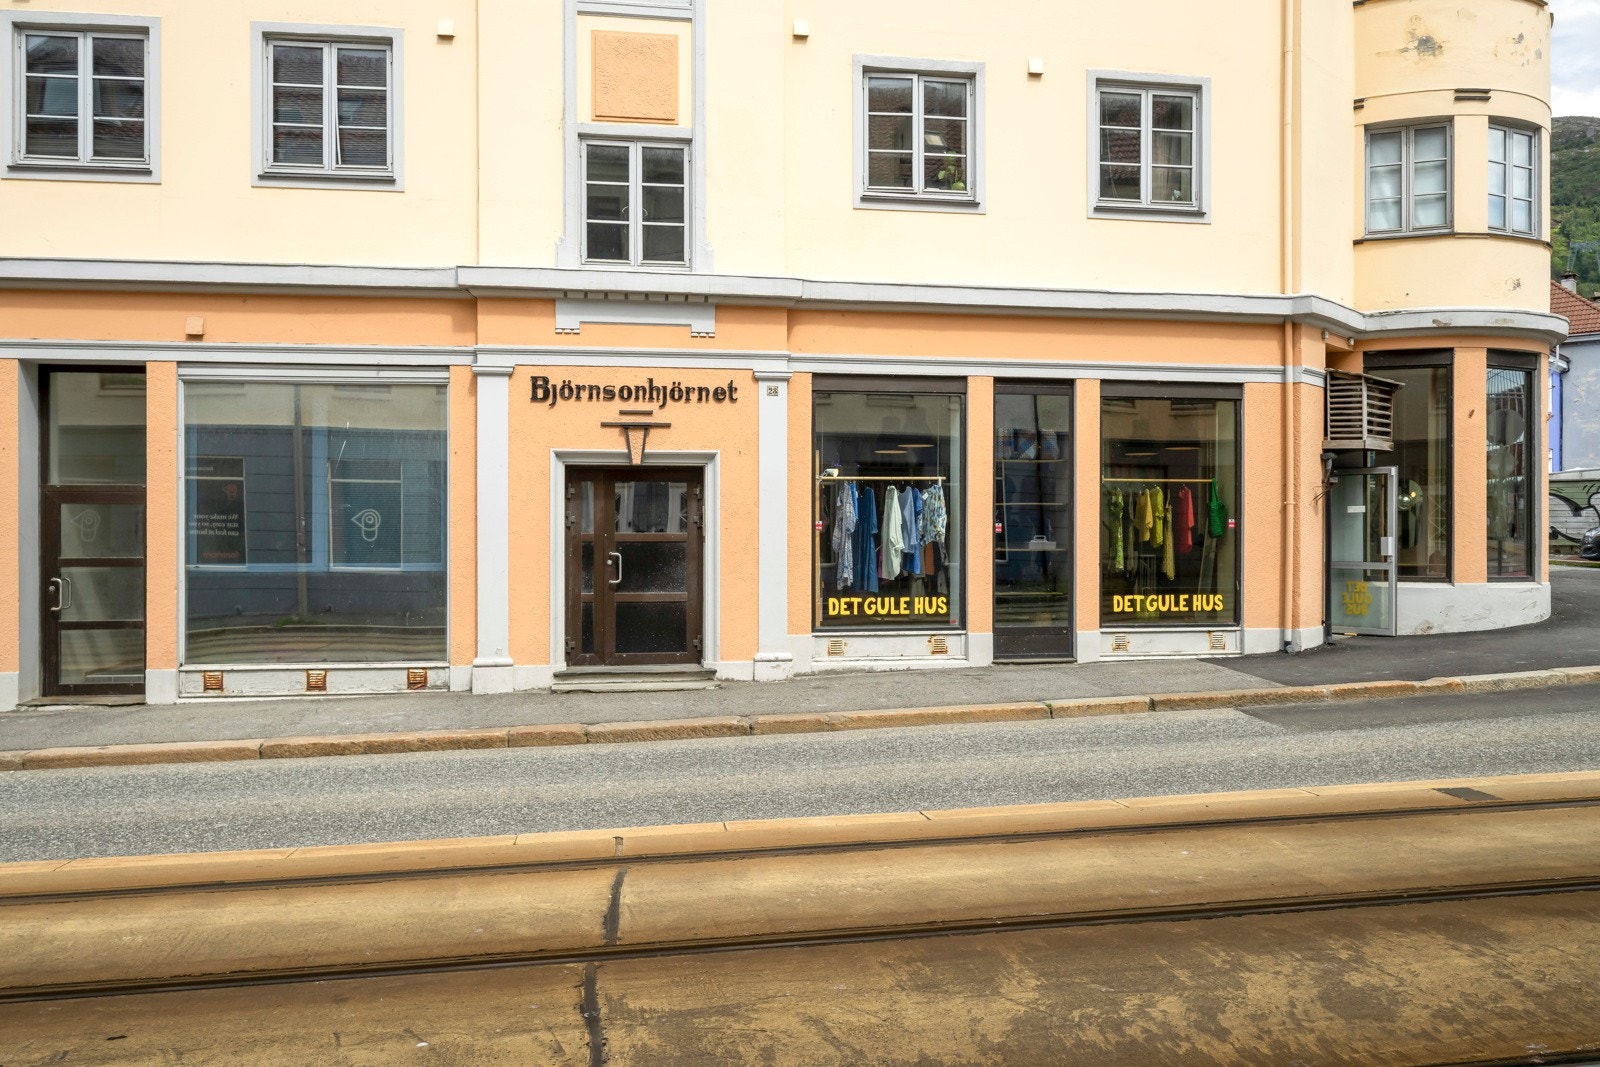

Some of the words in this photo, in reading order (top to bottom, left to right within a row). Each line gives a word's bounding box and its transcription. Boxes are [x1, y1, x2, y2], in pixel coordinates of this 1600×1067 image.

[530, 375, 738, 409] Björnsonhjörnet
[828, 597, 862, 616] DET
[864, 596, 911, 615] GULE
[914, 596, 948, 615] HUS
[1113, 594, 1144, 612] DET
[1146, 594, 1189, 612] GULE
[1192, 594, 1224, 612] HUS
